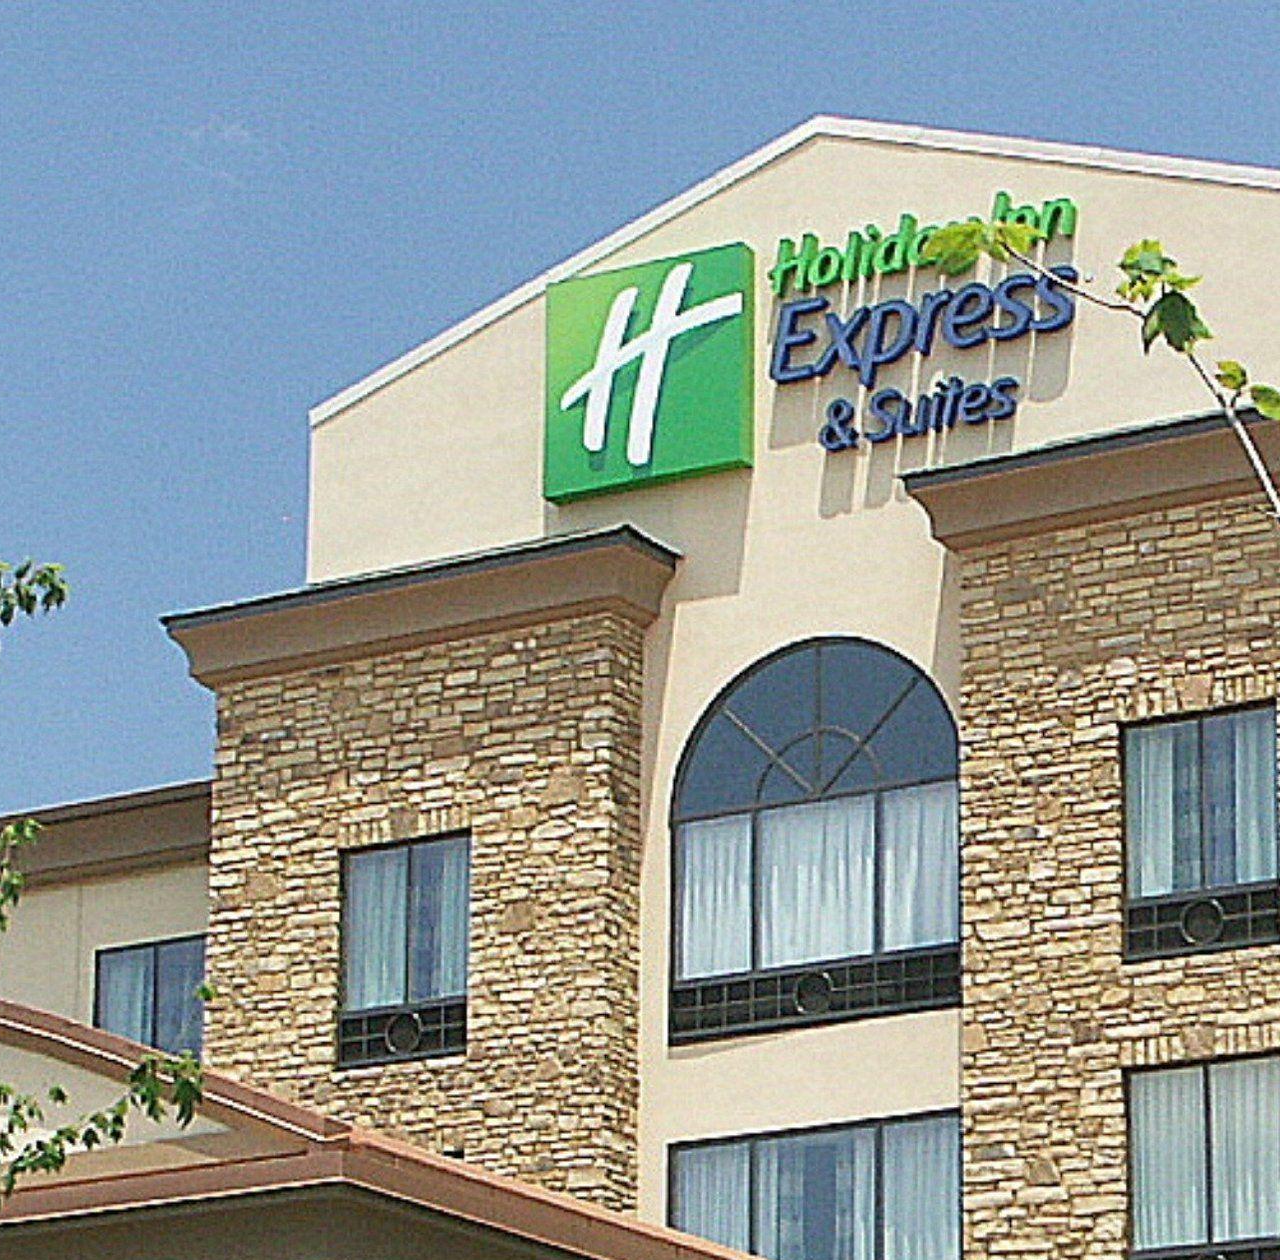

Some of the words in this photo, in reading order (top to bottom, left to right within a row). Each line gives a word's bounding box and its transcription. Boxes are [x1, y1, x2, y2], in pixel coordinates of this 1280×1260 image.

[770, 264, 1078, 390] Express
[818, 397, 860, 452] &
[864, 376, 1020, 443] Suites
